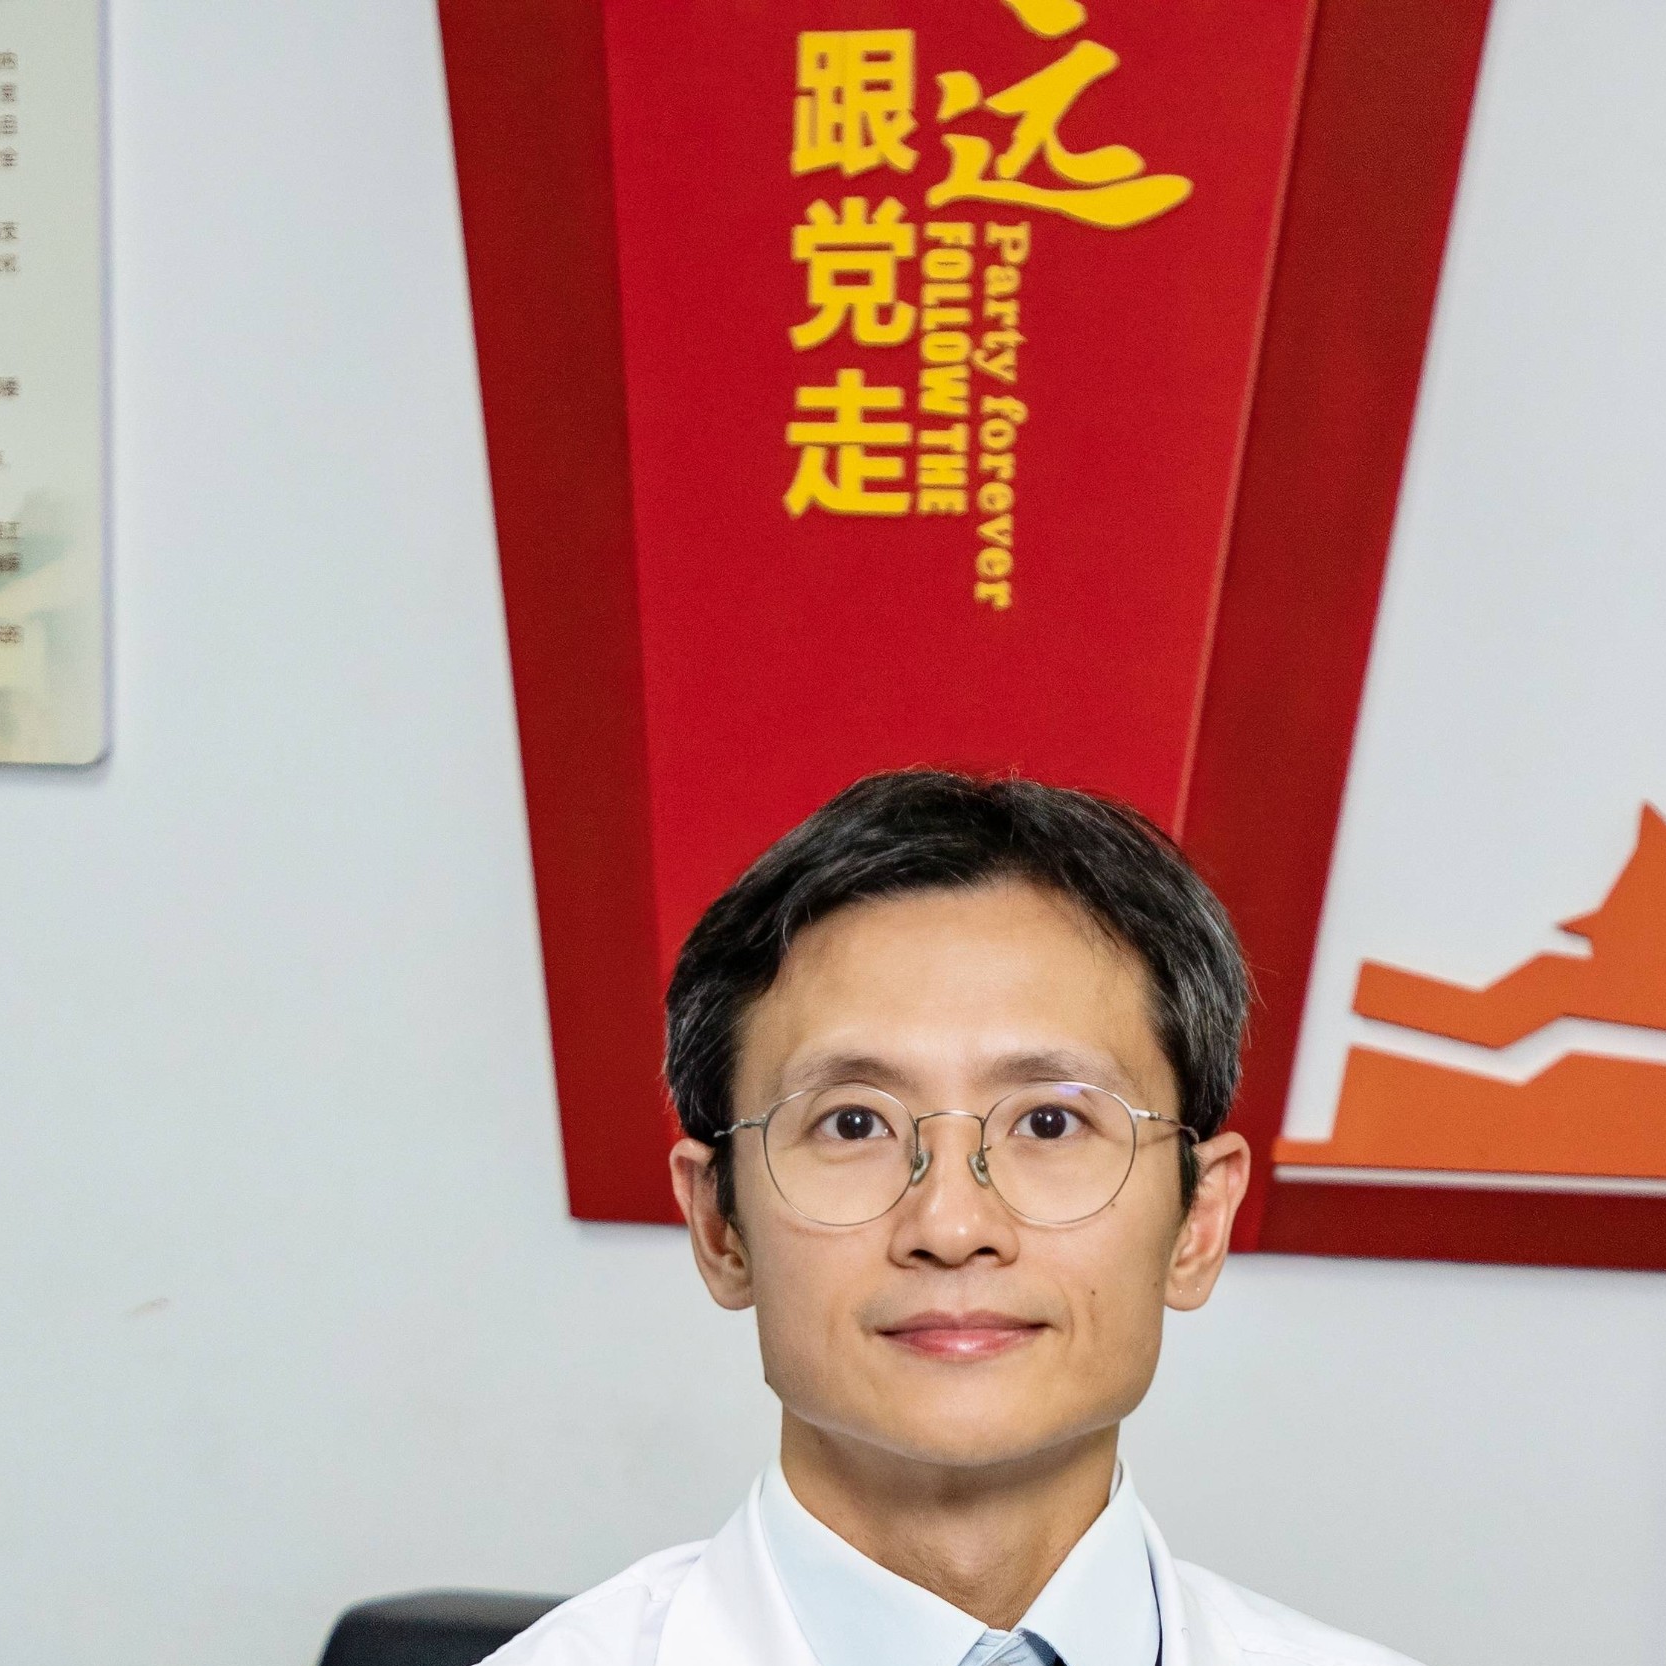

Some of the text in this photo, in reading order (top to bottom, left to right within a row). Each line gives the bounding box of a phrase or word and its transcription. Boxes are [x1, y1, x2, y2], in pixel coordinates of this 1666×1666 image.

[784, 28, 920, 520] 跟党走
[917, 221, 974, 516] FOLLOW THE
[973, 221, 1030, 611] Party forever
